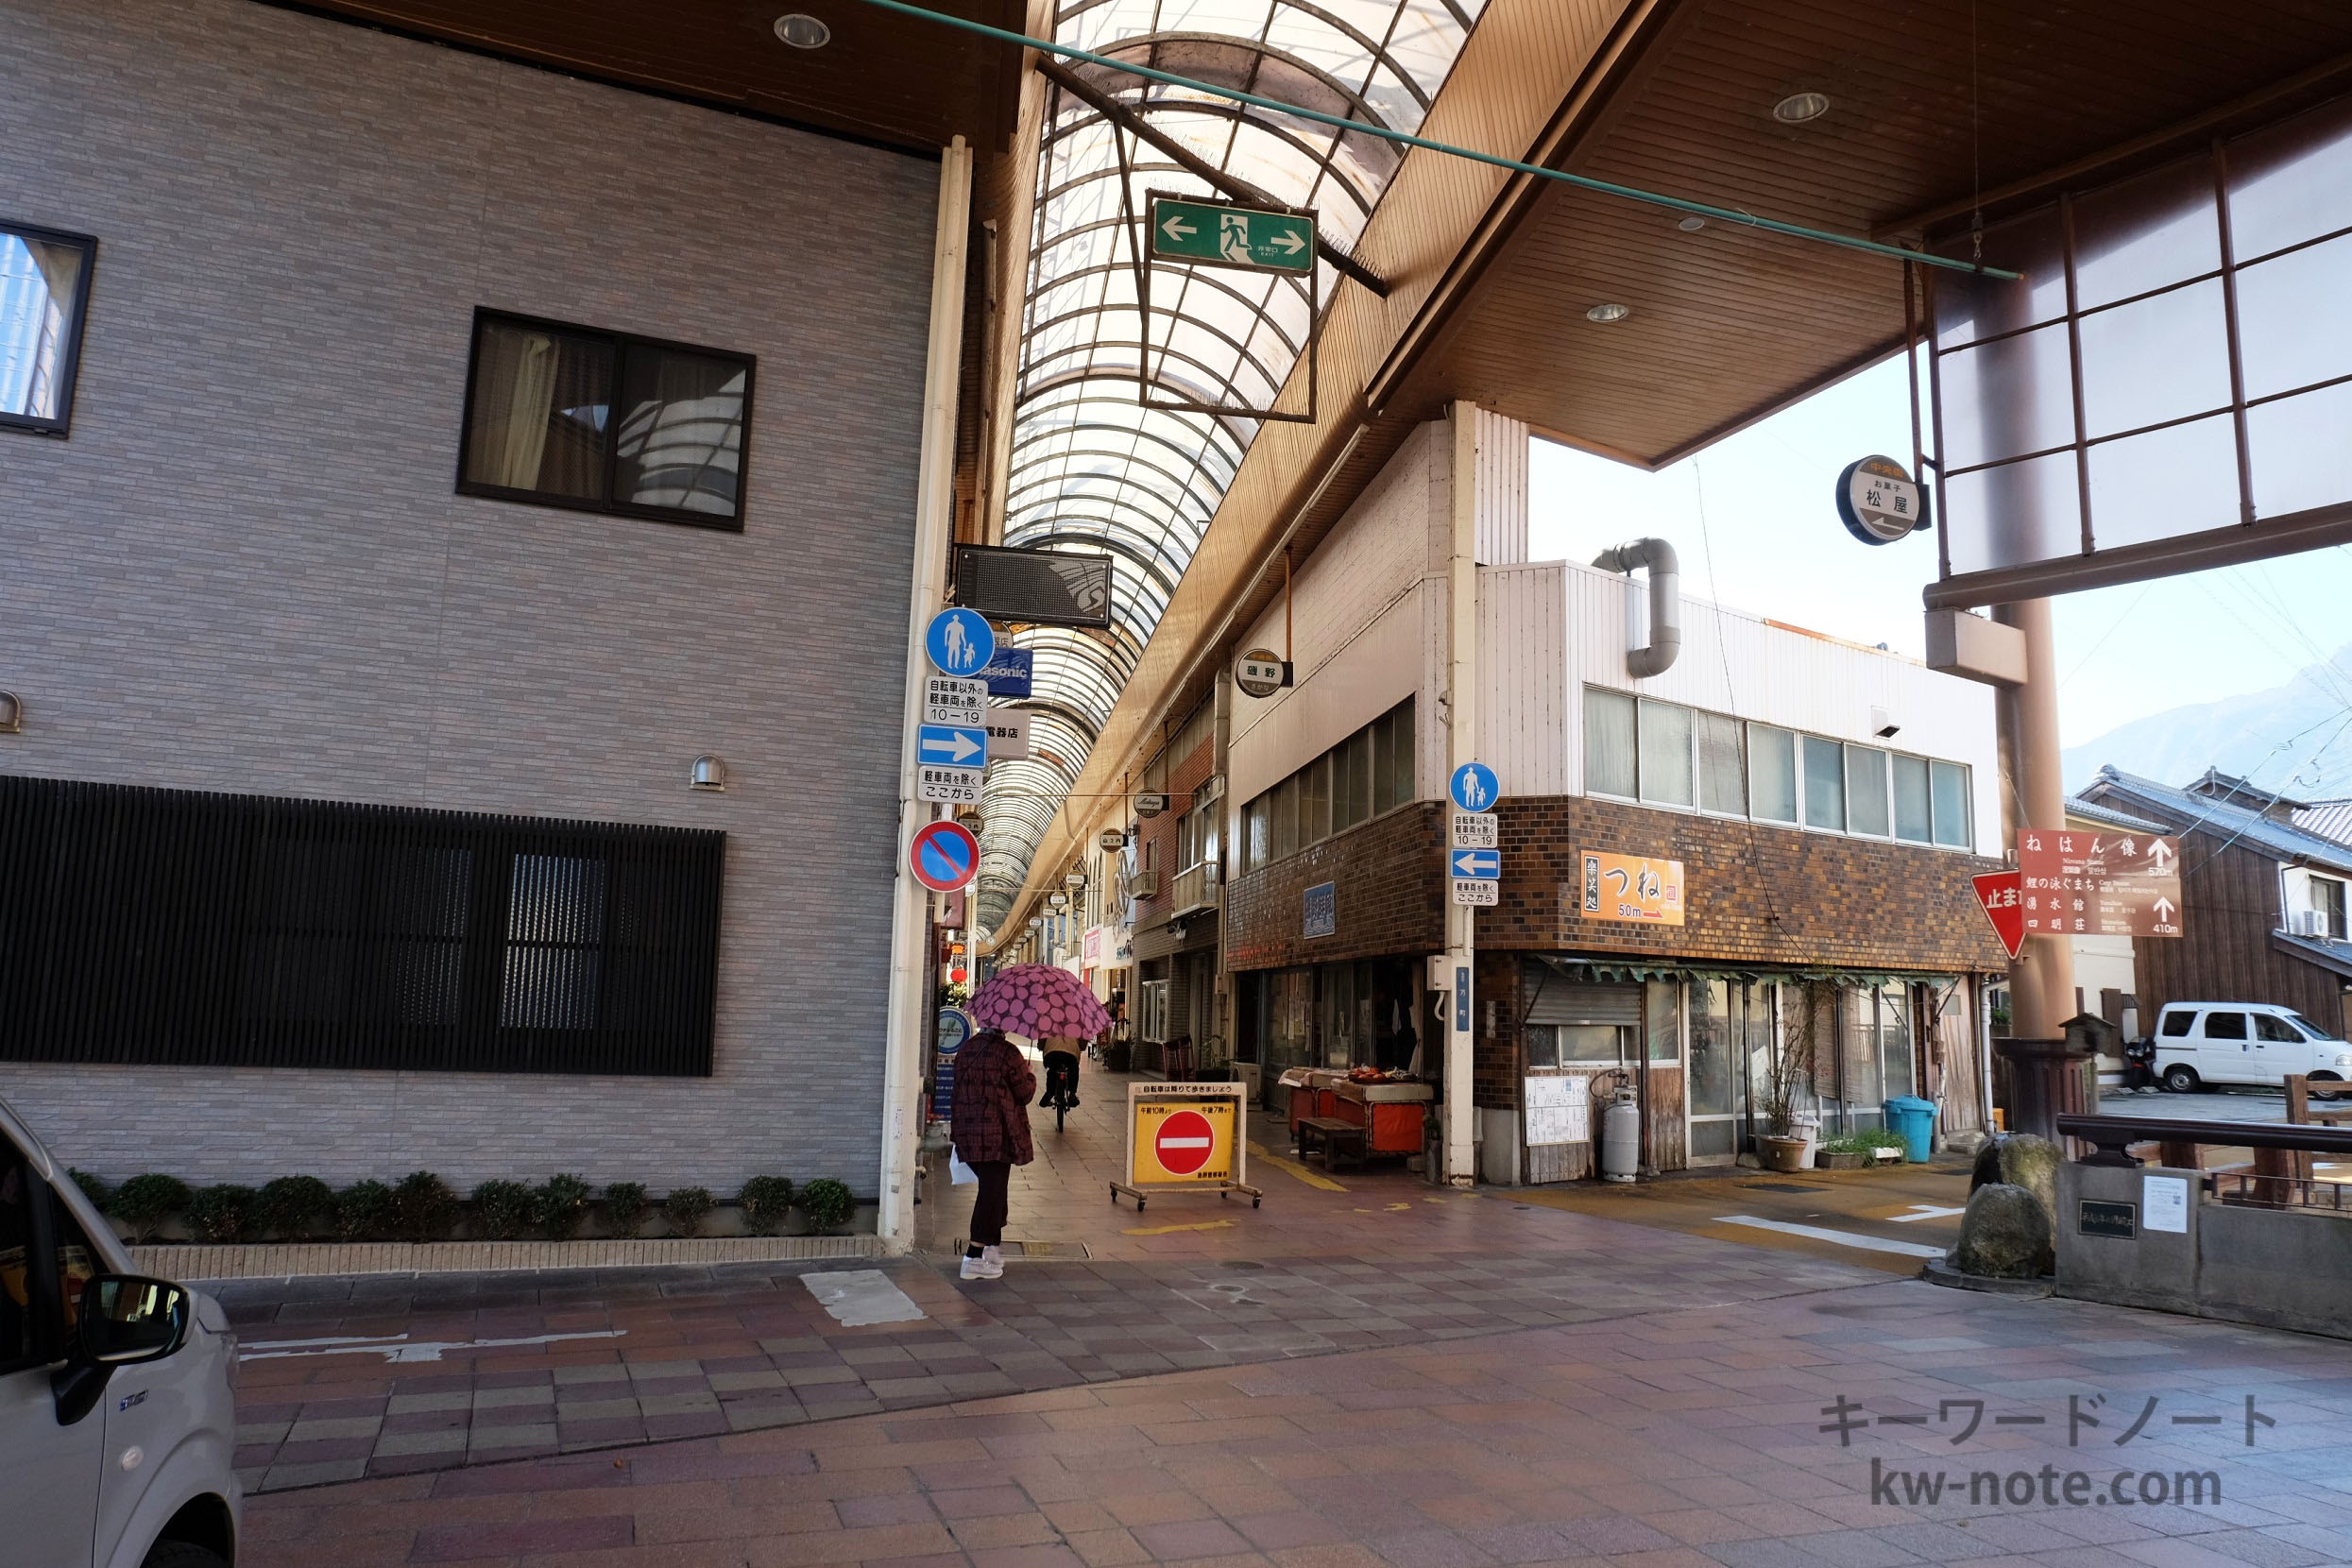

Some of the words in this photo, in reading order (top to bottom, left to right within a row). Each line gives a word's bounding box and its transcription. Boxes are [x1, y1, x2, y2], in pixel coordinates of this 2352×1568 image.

[1875, 480, 1901, 492] お菓子
[1866, 488, 1908, 514] 松屋
[980, 665, 1028, 678] asonic
[929, 680, 983, 695] 自転車以外の
[929, 692, 982, 709] 軽車両を除く
[924, 770, 977, 786] 軽車両を除く
[926, 786, 974, 800] ここから
[1455, 816, 1495, 826] 自転車以外の
[1455, 825, 1494, 834] 軽車両を除く
[2026, 834, 2138, 857] ねはん像
[2147, 867, 2173, 877] 570m
[1457, 882, 1494, 892] 軽車両を除く
[1605, 863, 1661, 901] つね
[2026, 876, 2095, 891] 鯉の泳ぐまち
[1457, 894, 1492, 902] ここから
[1618, 904, 1642, 917] 50m
[2027, 918, 2086, 930] 四明荘
[2153, 924, 2178, 933] 410m
